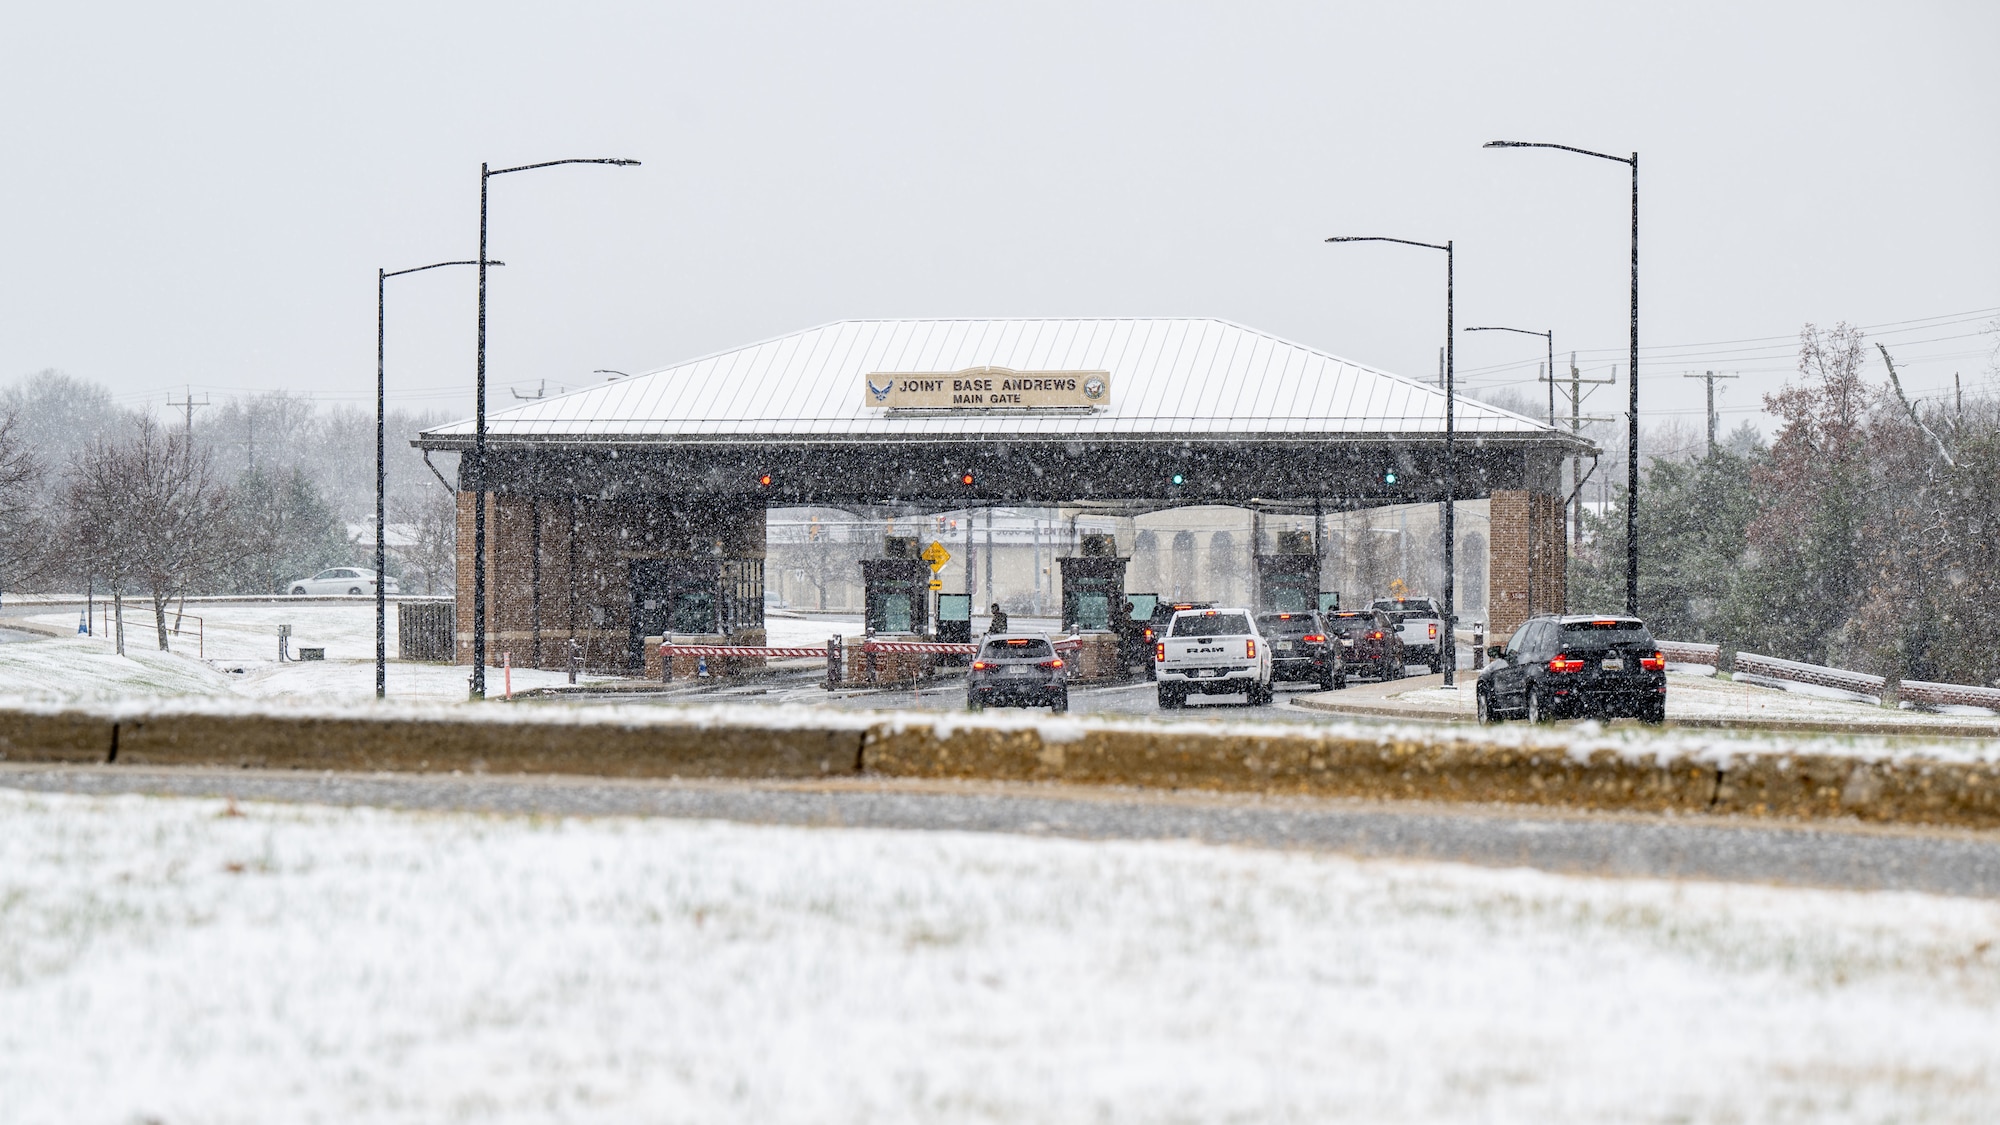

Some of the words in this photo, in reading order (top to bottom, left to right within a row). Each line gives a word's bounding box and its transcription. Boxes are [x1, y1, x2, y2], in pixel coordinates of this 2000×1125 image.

[899, 380, 944, 392] JOINT
[953, 379, 992, 391] BASE
[1002, 378, 1076, 391] ANDREWS
[953, 394, 983, 404] MAIN
[990, 393, 1021, 403] GATE
[1022, 527, 1085, 536] ALENTOWN
